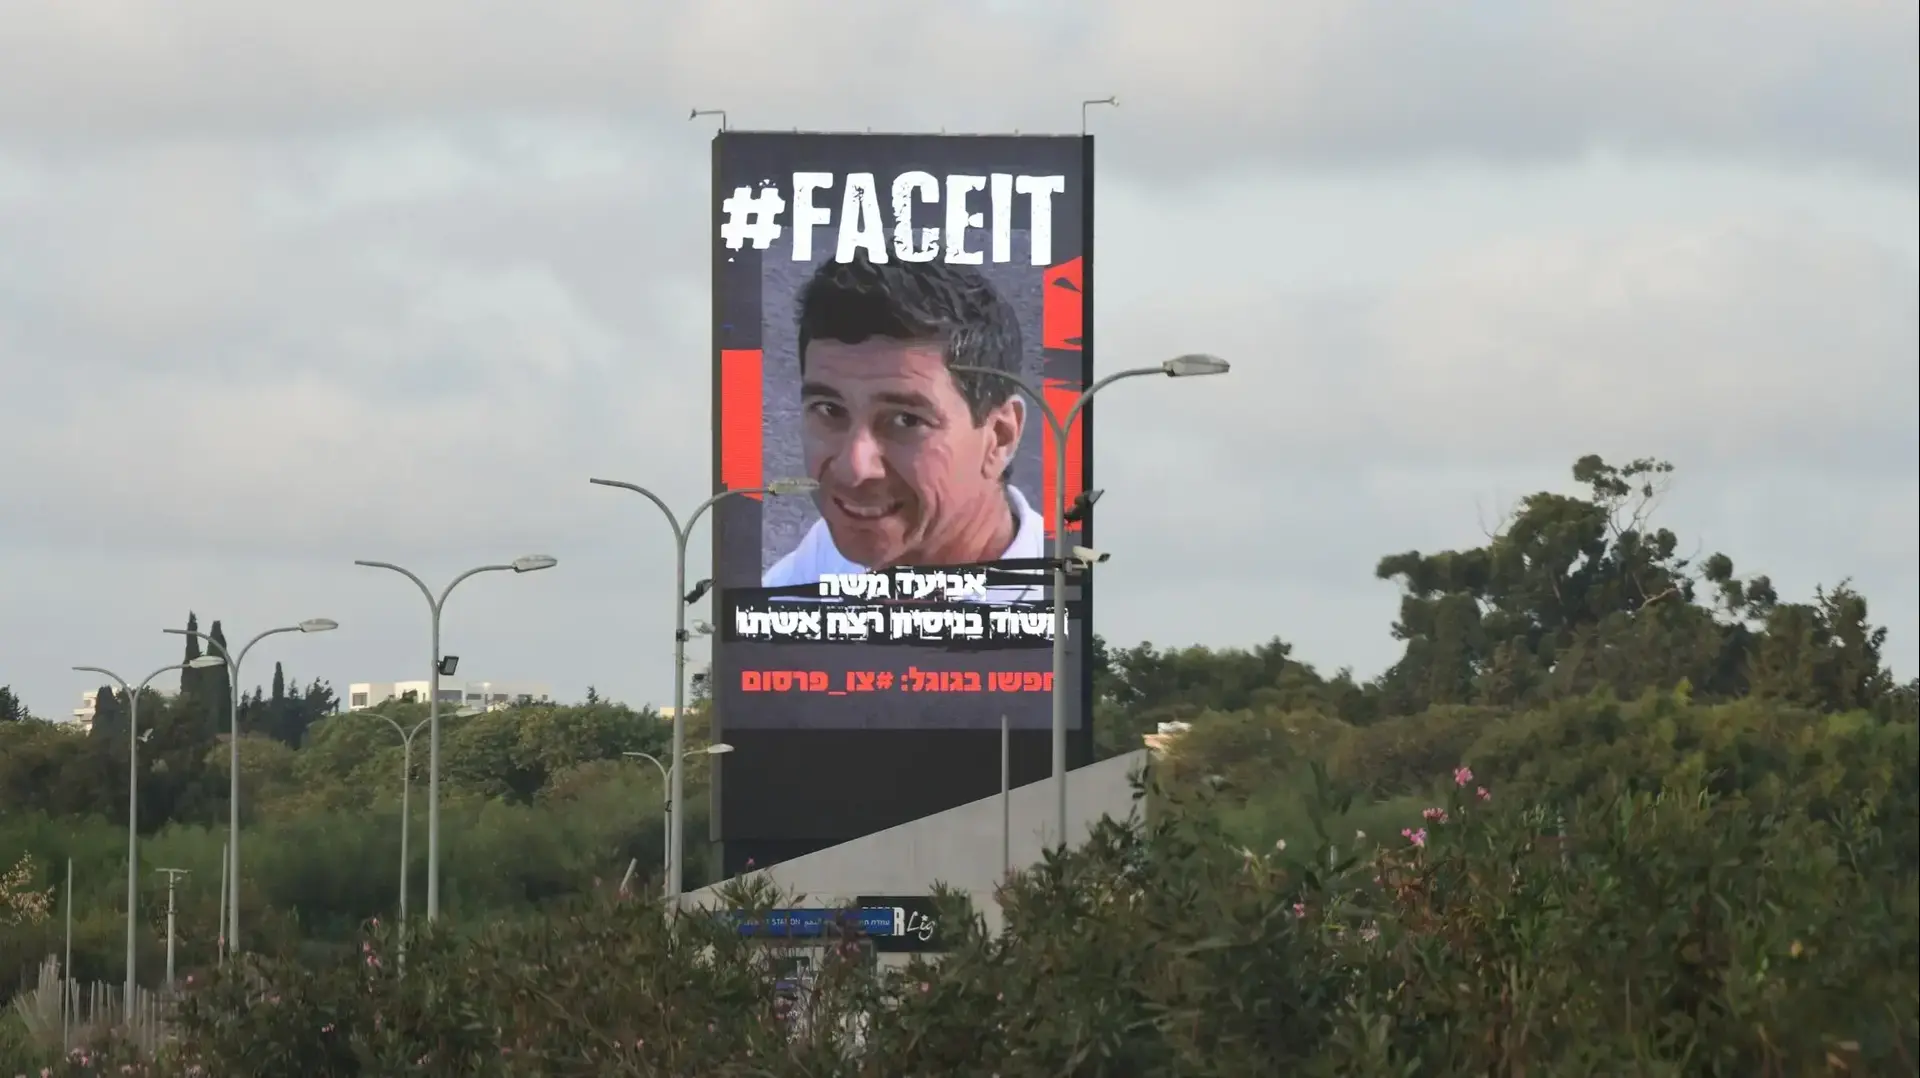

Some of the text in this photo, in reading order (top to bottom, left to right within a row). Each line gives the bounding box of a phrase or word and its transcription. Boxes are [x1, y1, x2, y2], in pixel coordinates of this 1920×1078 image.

[819, 569, 986, 601] אביעד משה
[736, 605, 821, 639] אשתו
[826, 605, 884, 640] רצח
[890, 606, 983, 640] בניסיון
[741, 670, 895, 695] #צו_פרסום
[901, 666, 981, 692] בגוגל:
[771, 917, 801, 926] STATON
